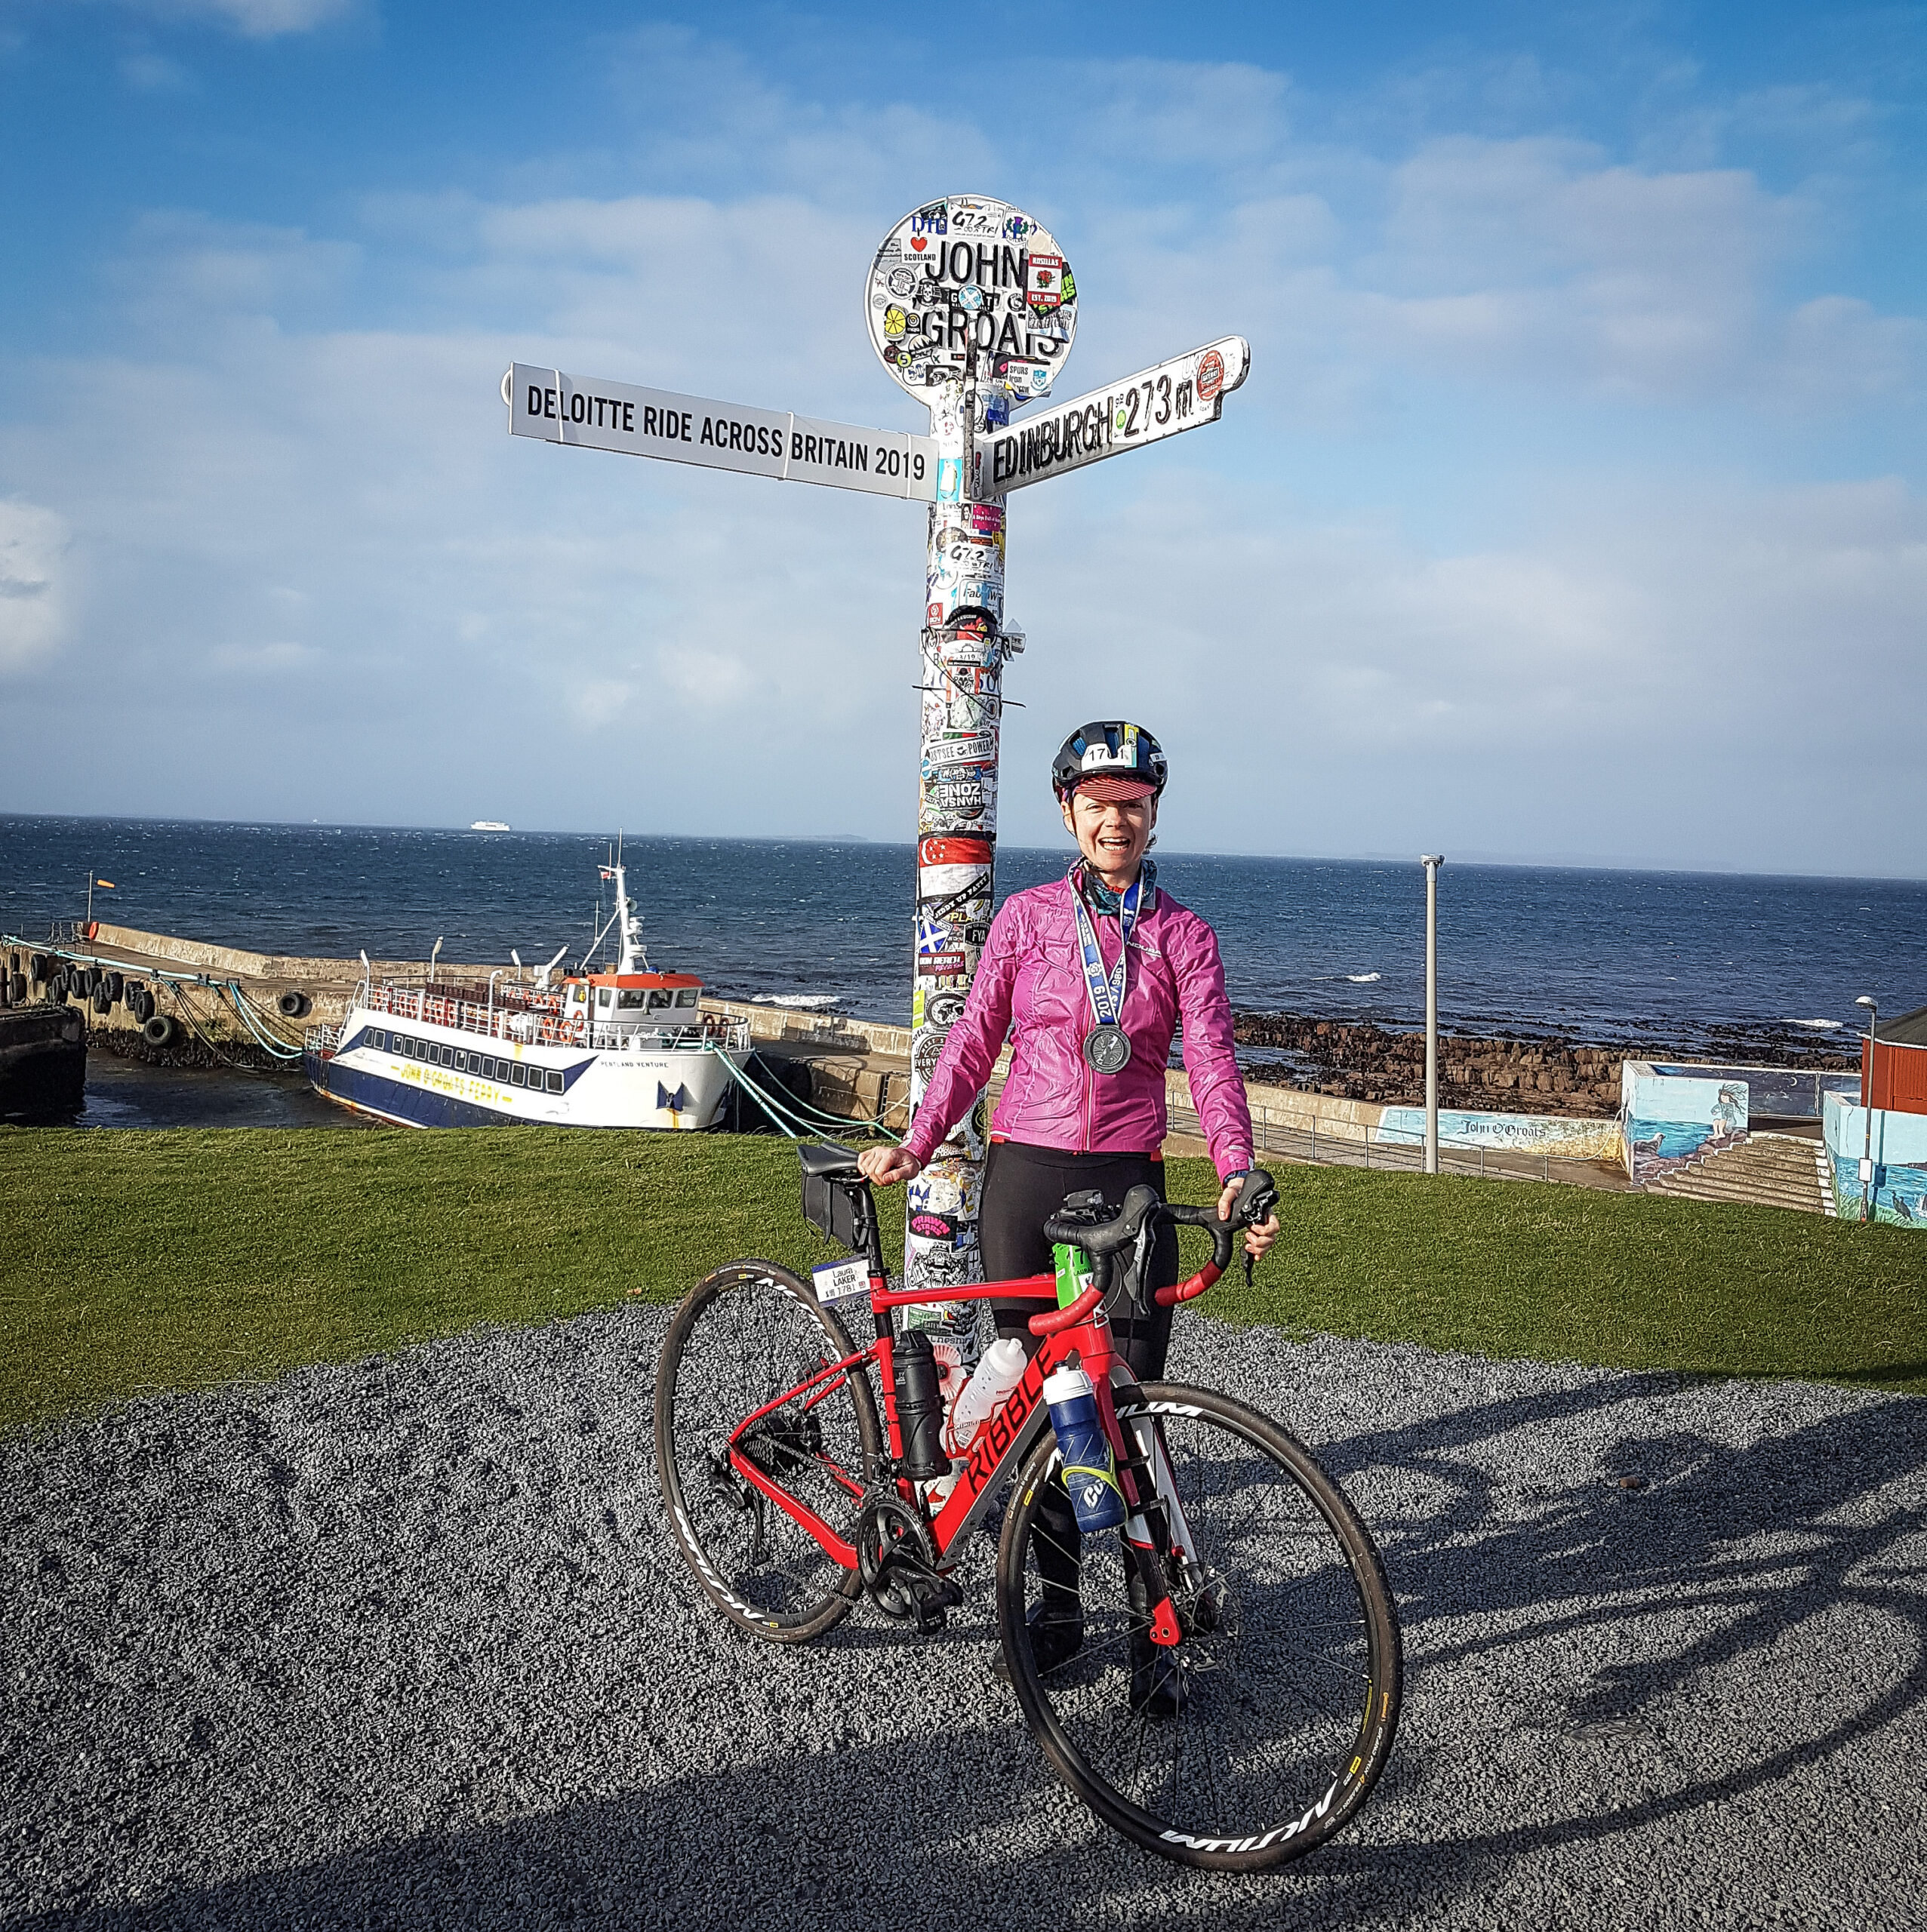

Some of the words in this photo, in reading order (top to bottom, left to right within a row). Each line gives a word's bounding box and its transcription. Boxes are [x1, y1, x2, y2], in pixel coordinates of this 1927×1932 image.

[903, 253, 937, 262] SCOTLAND
[925, 241, 1025, 288] JOHN
[1009, 366, 1029, 376] SPURS
[527, 385, 635, 432] DELOITTE
[644, 405, 693, 443] RIDE
[700, 417, 783, 458] ACROSS
[791, 432, 869, 472] BRITAIN
[874, 447, 925, 481] 2019
[993, 396, 1114, 484] EDINBURGH
[1124, 374, 1172, 438] 273
[1090, 748, 1125, 761] 171
[939, 783, 981, 797] ZONE
[940, 796, 981, 808] HANSA
[971, 930, 986, 943] FYA
[1125, 940, 1162, 956] NDURA
[1097, 985, 1112, 1018] 2019
[401, 1063, 422, 1081] JOHN
[469, 1081, 501, 1105] FERRY
[1458, 1119, 1490, 1135] John
[910, 1215, 951, 1235] PRAWN
[833, 1274, 857, 1287] LAKER
[967, 1350, 1056, 1495] RIBBLE
